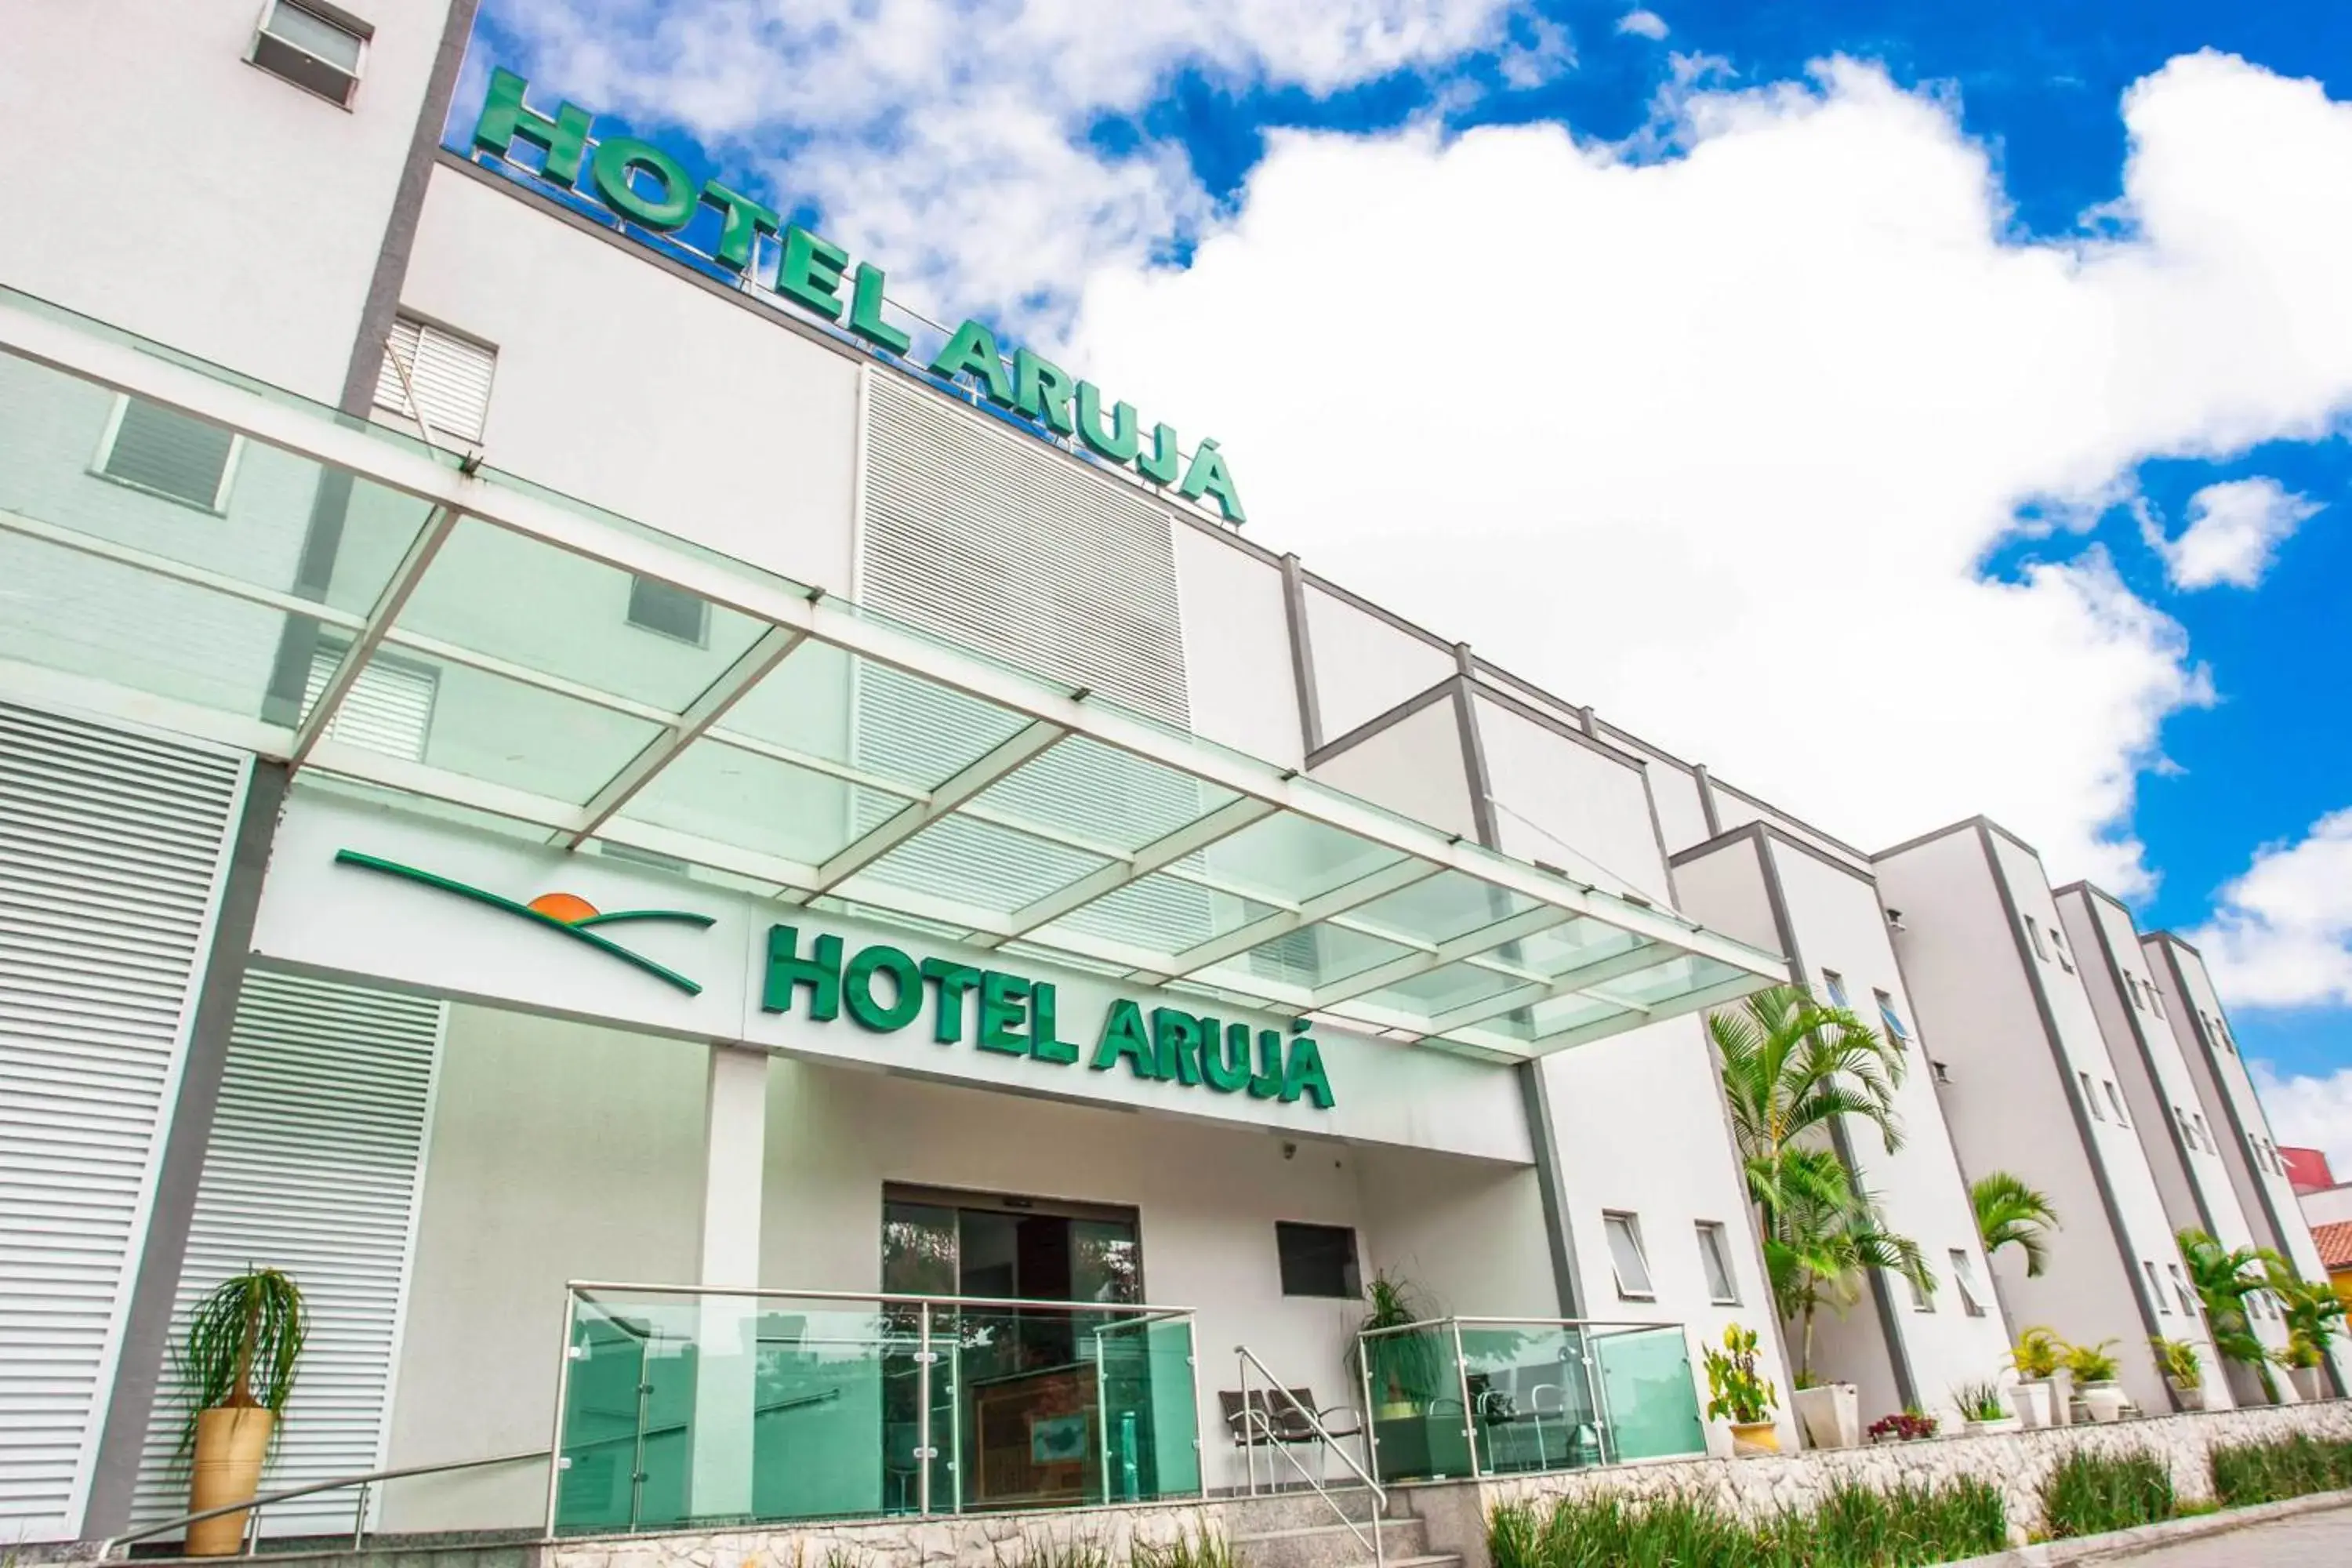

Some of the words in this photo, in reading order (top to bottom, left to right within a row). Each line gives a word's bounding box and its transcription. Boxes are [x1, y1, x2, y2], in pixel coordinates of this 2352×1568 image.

[474, 65, 910, 356] HOTEL
[928, 319, 1247, 526] ARUJÁ
[762, 924, 1080, 1065] HOTEL
[1090, 998, 1336, 1109] ARUJÁ
